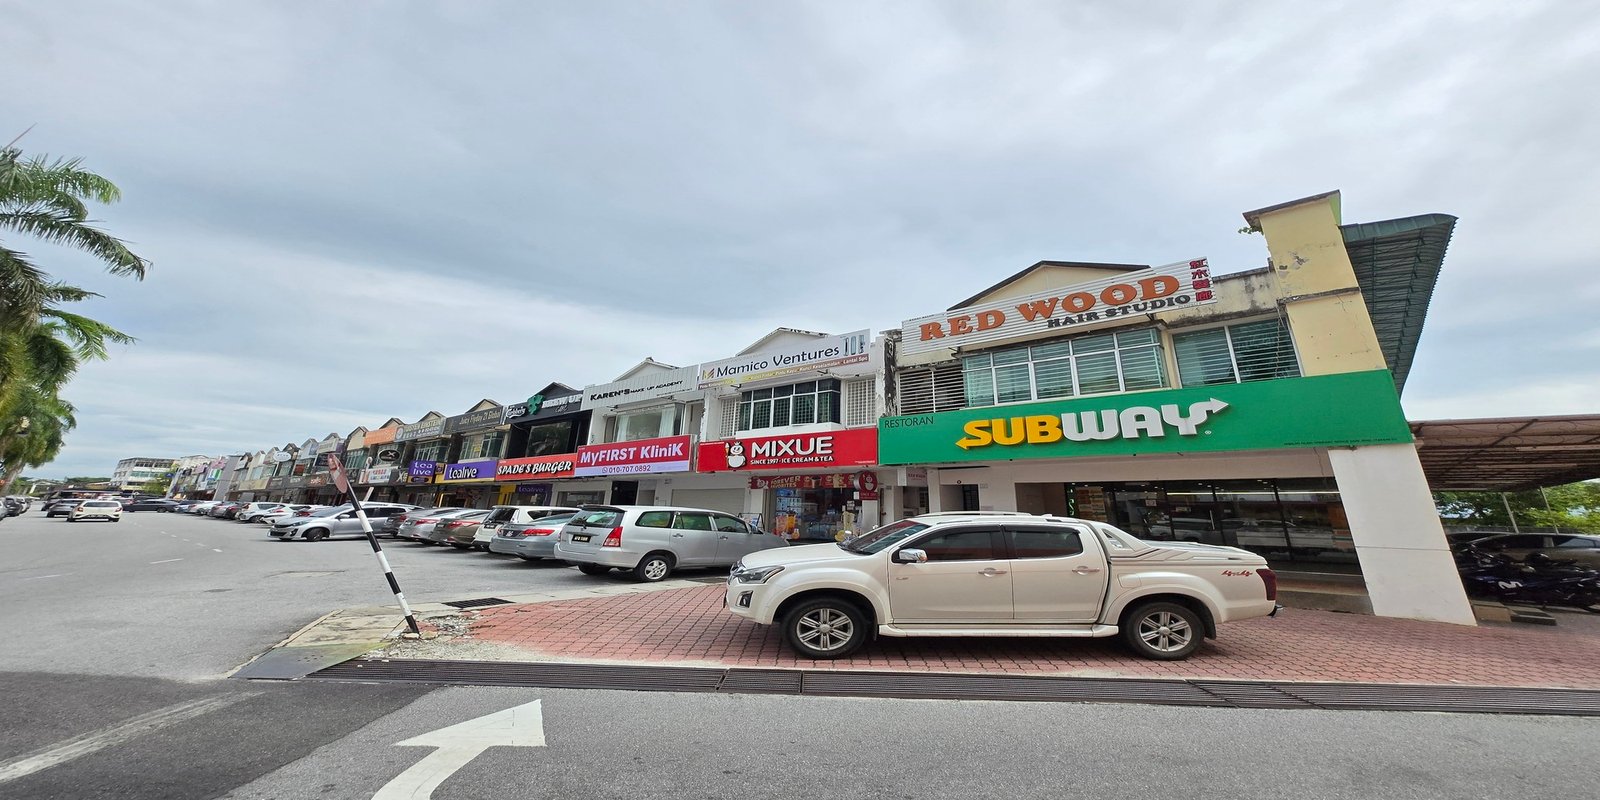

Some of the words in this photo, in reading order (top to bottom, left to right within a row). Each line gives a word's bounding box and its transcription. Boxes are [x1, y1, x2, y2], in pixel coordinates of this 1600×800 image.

[919, 308, 1006, 342] RED
[1015, 275, 1180, 324] WOOD
[1047, 310, 1101, 329] HAIR
[1104, 294, 1191, 319] STUDIO
[716, 359, 768, 378] Mamico
[772, 345, 840, 367] Ventures
[590, 388, 631, 401] KAREN'S
[655, 379, 684, 390] ACADEMY
[884, 415, 934, 429] RESTORAN
[955, 396, 1230, 450] SUBWAY
[580, 447, 637, 466] MyFIRST
[640, 441, 684, 459] KliniK
[751, 436, 833, 458] MIXUE
[413, 468, 432, 476] live
[414, 461, 433, 469] tea
[448, 466, 478, 480] tealive
[497, 461, 532, 475] SPADE'S
[532, 460, 573, 475] BURGER
[608, 466, 634, 474] 010-707
[634, 464, 651, 473] 0892
[770, 475, 801, 485] FOREVER
